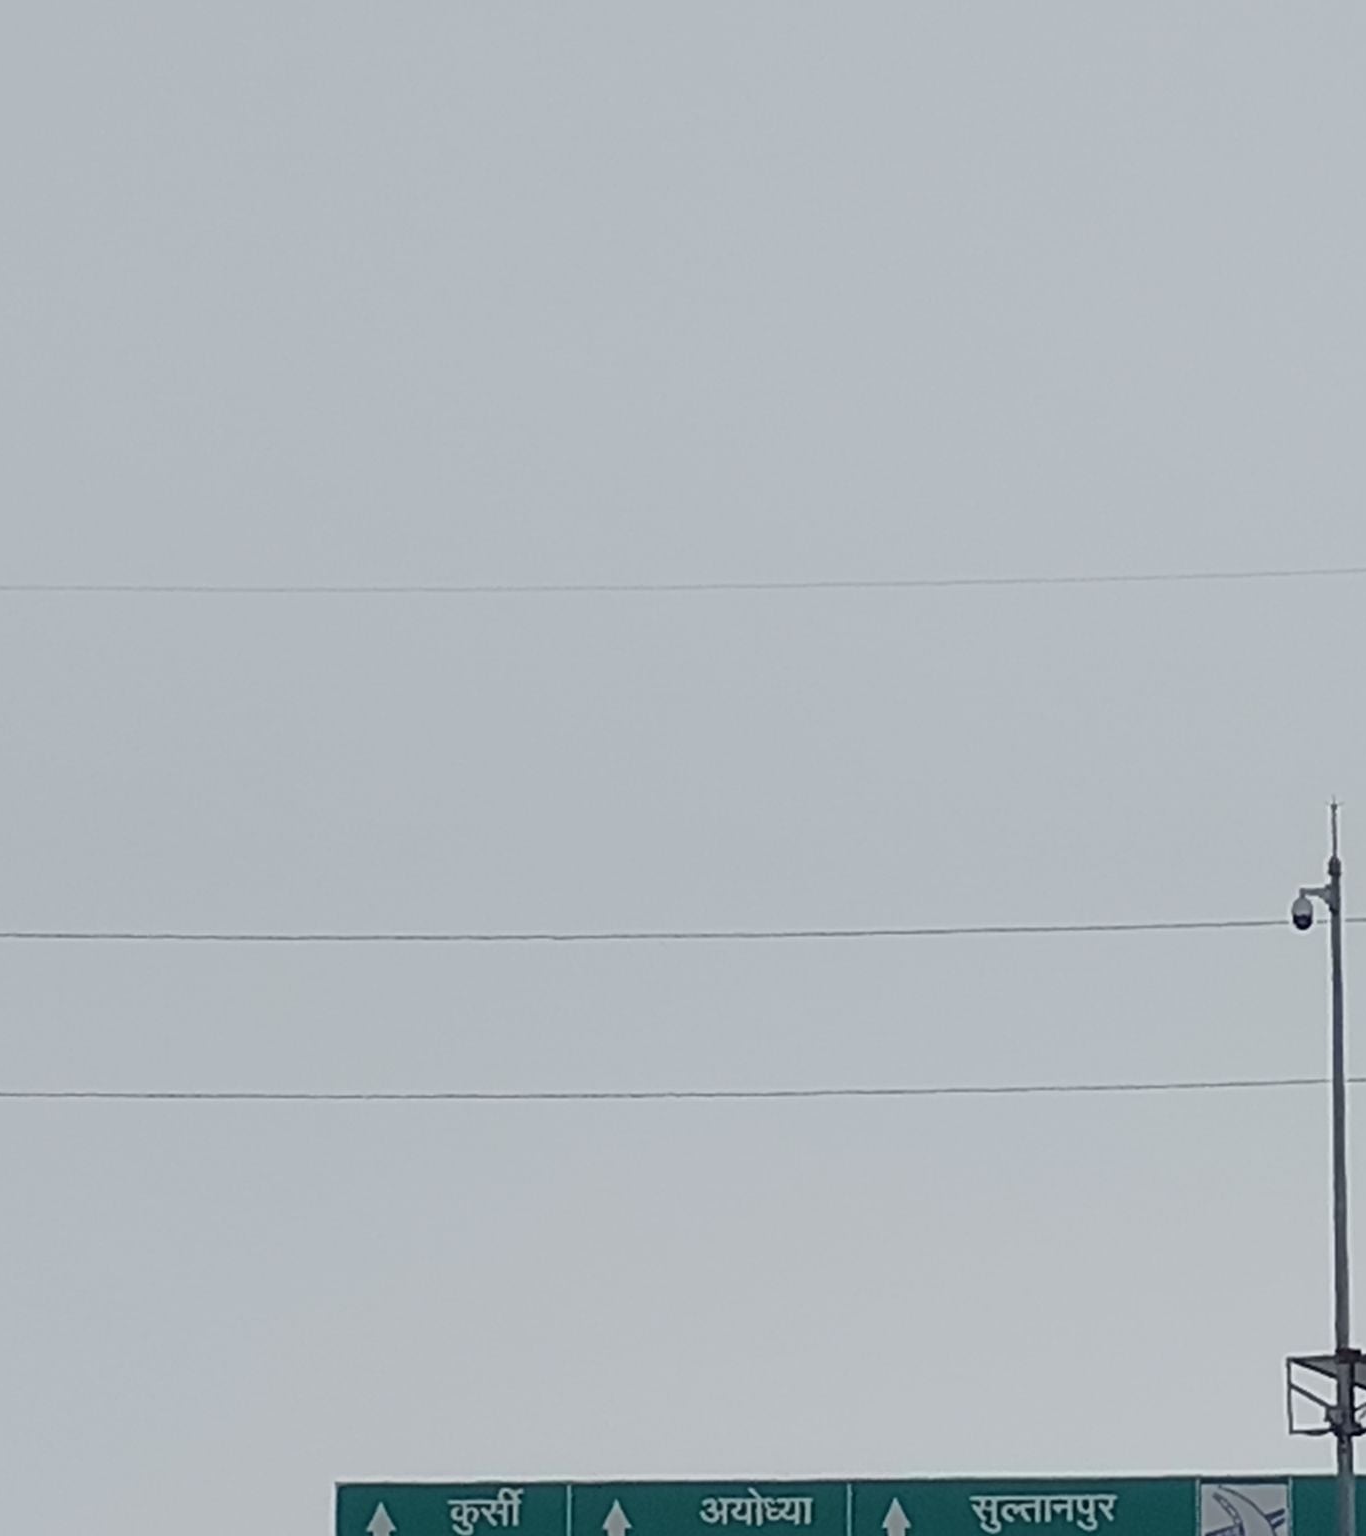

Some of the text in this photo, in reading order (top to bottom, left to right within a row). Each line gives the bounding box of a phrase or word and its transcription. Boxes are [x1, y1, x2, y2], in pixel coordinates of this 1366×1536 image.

[447, 1487, 524, 1536] कुर्सी
[699, 1487, 813, 1528] अयोध्या
[969, 1493, 1118, 1531] सुल्तानपुर
